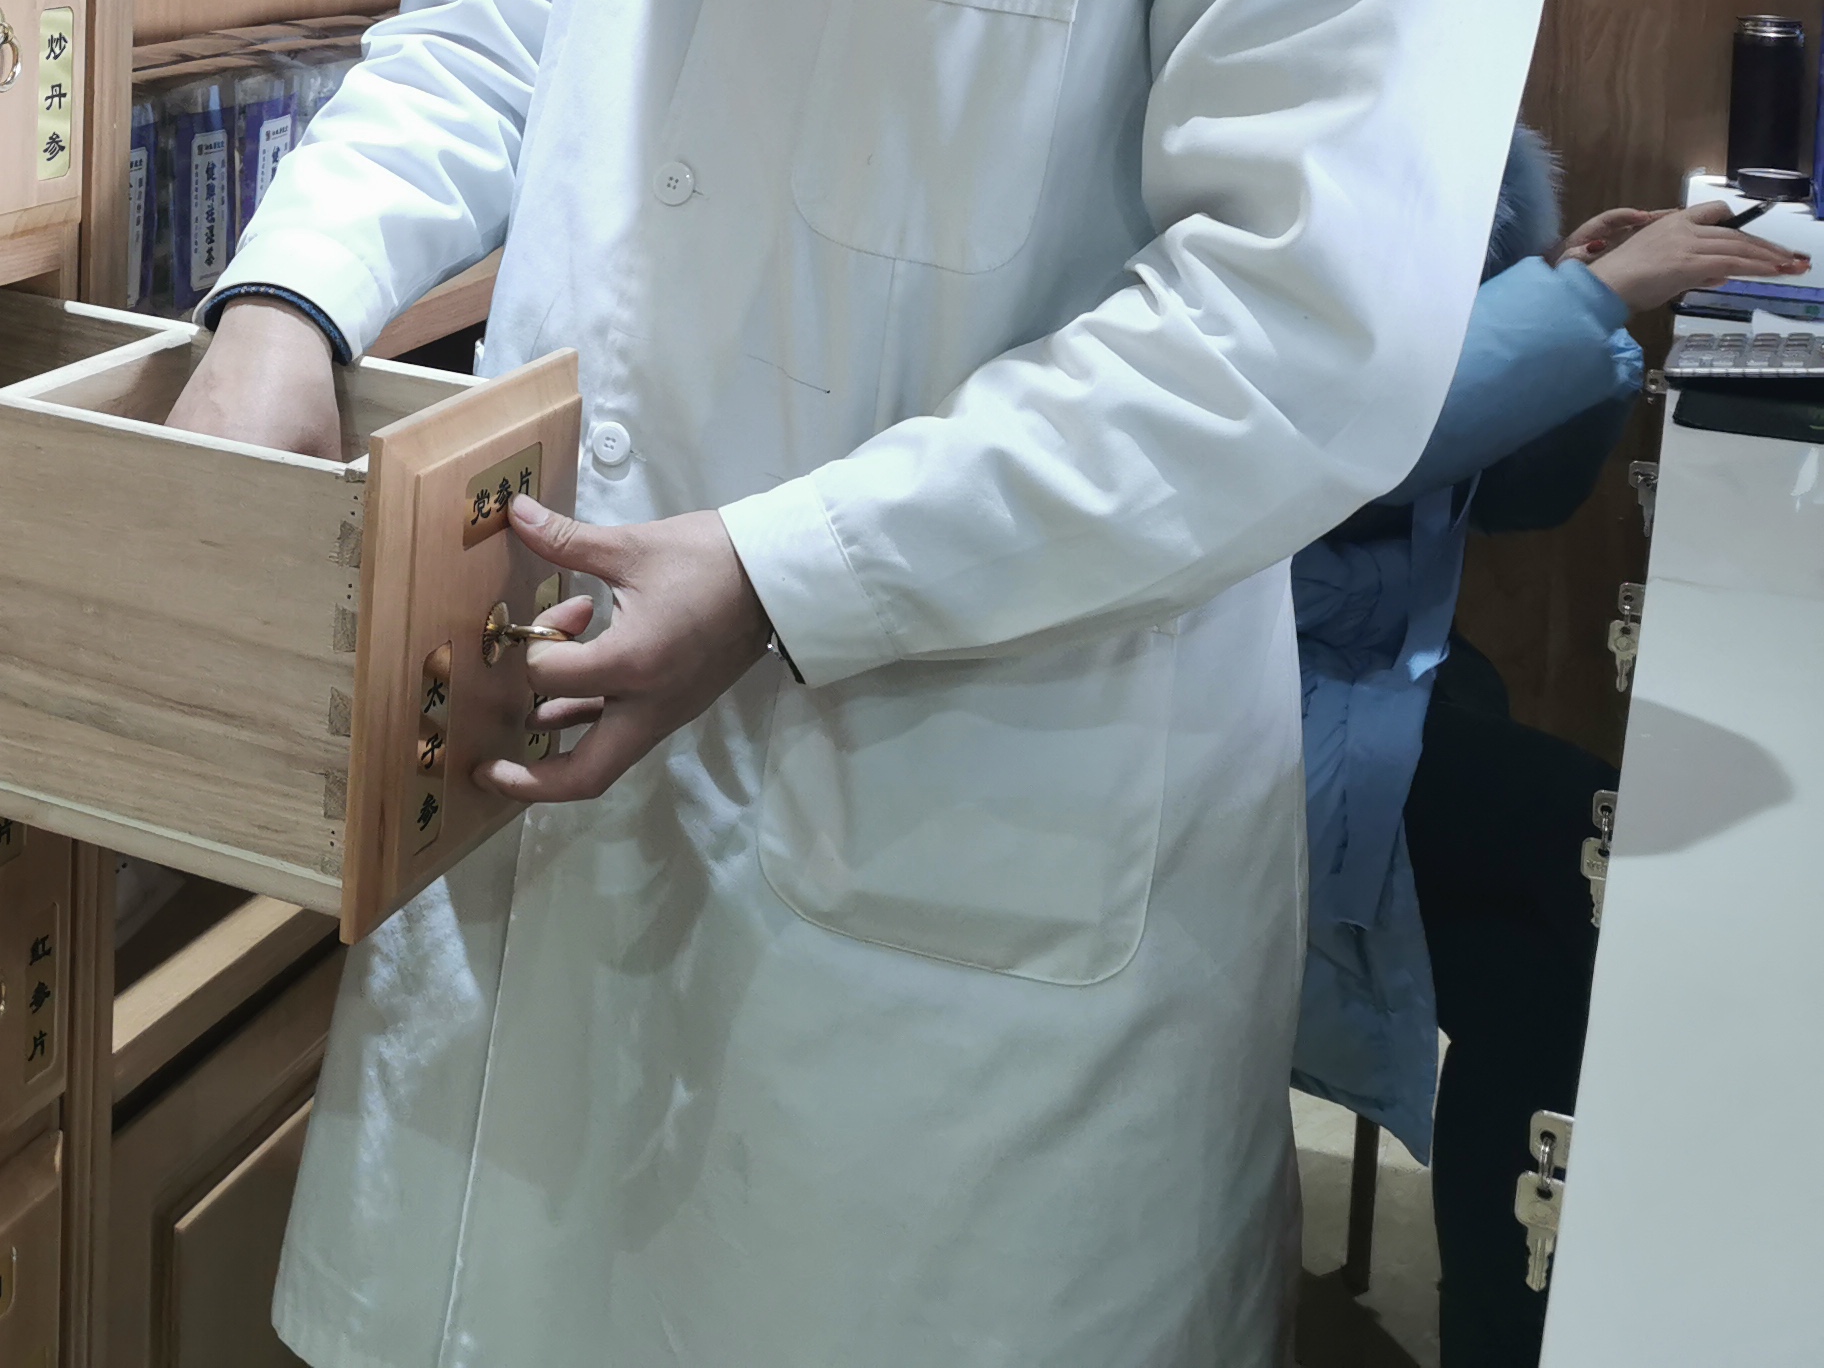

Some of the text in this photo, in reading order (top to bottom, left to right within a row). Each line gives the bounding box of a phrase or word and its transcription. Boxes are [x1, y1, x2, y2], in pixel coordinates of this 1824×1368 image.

[43, 33, 67, 162] 炒丹参
[471, 467, 532, 526] 党参片
[417, 677, 445, 831] 太子参
